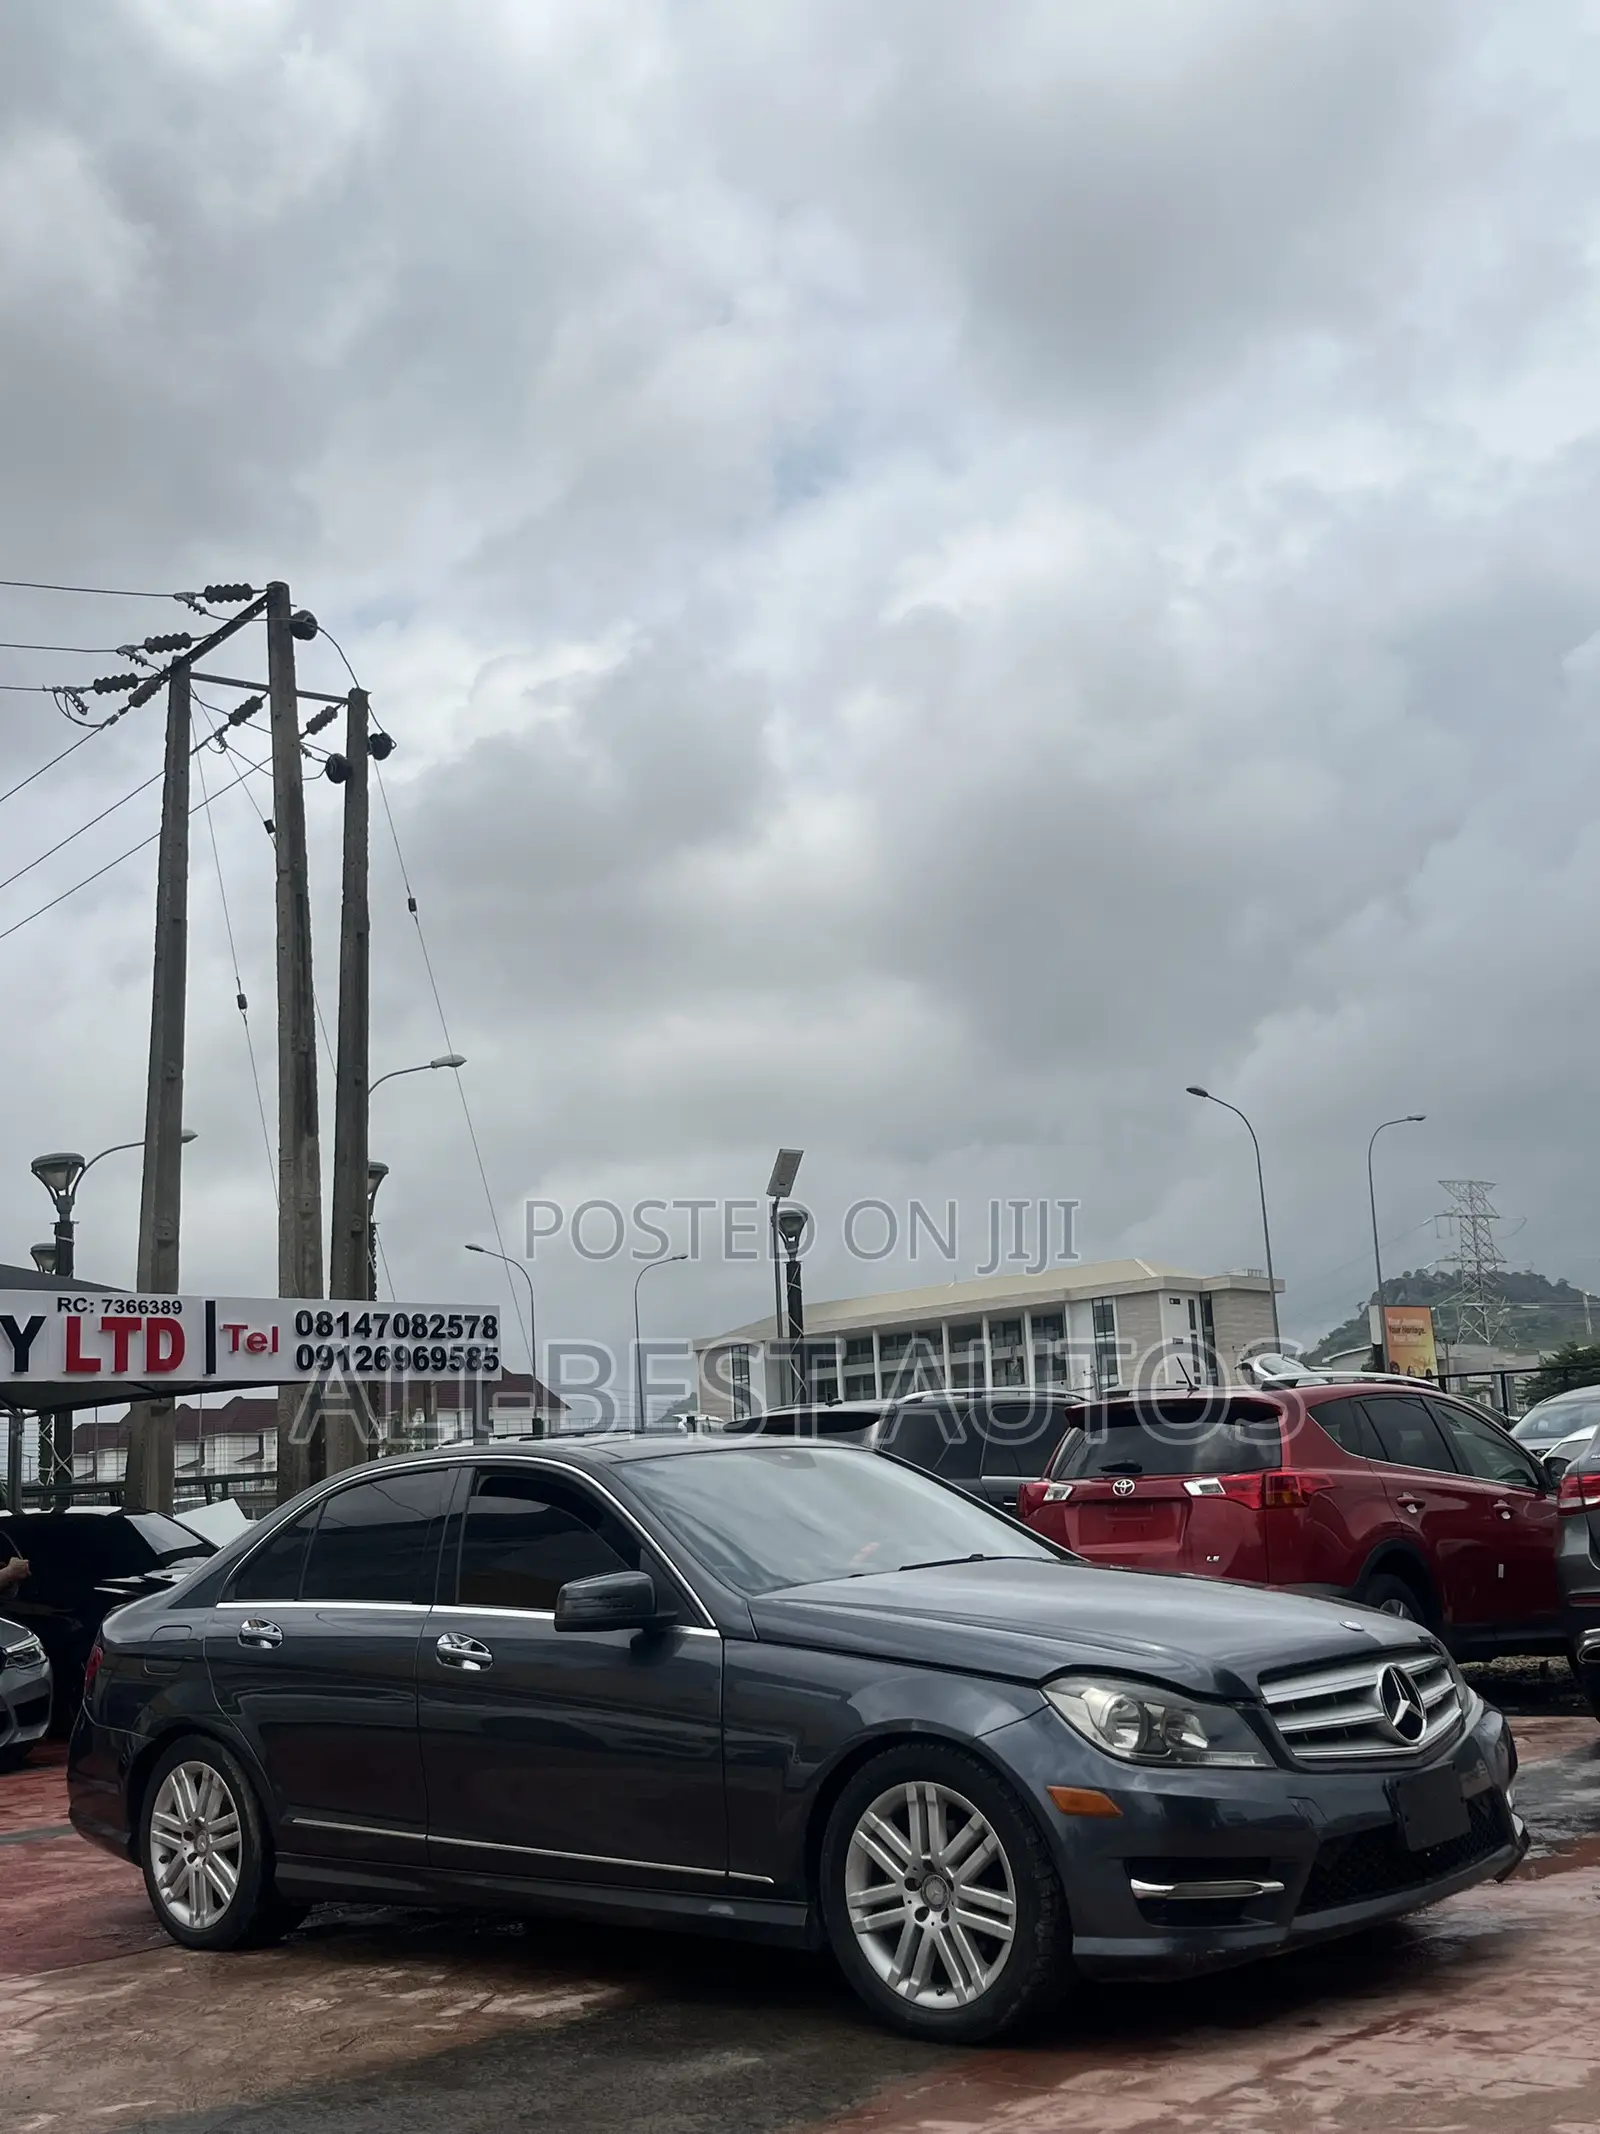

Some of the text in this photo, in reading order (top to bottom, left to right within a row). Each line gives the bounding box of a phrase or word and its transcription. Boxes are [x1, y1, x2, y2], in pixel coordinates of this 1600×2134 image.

[56, 1297, 183, 1315] RC: 7366389
[222, 1323, 279, 1353] Tel
[295, 1310, 498, 1340] 08147082578
[65, 1315, 186, 1373] LTD
[296, 1343, 500, 1372] 09126969585
